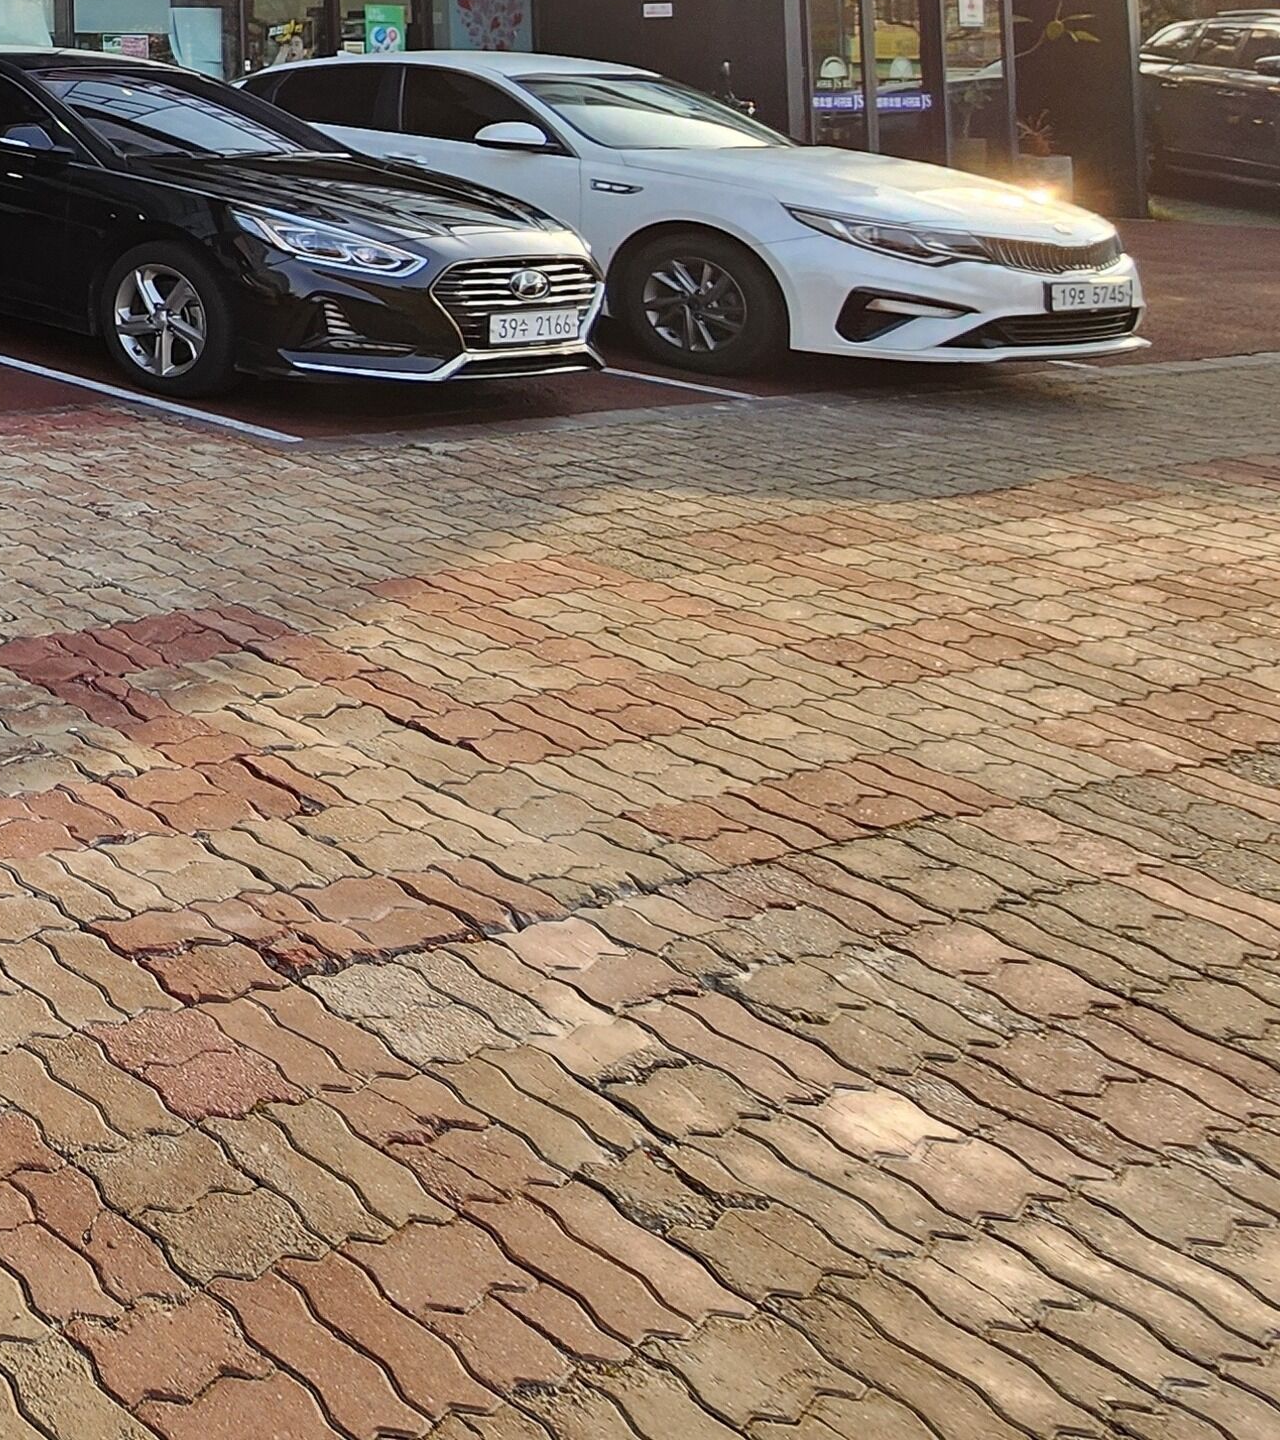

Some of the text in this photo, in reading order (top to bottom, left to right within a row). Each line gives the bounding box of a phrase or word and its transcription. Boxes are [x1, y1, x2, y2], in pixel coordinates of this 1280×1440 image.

[1092, 284, 1126, 304] 5745
[497, 313, 572, 339] 39수 2166
